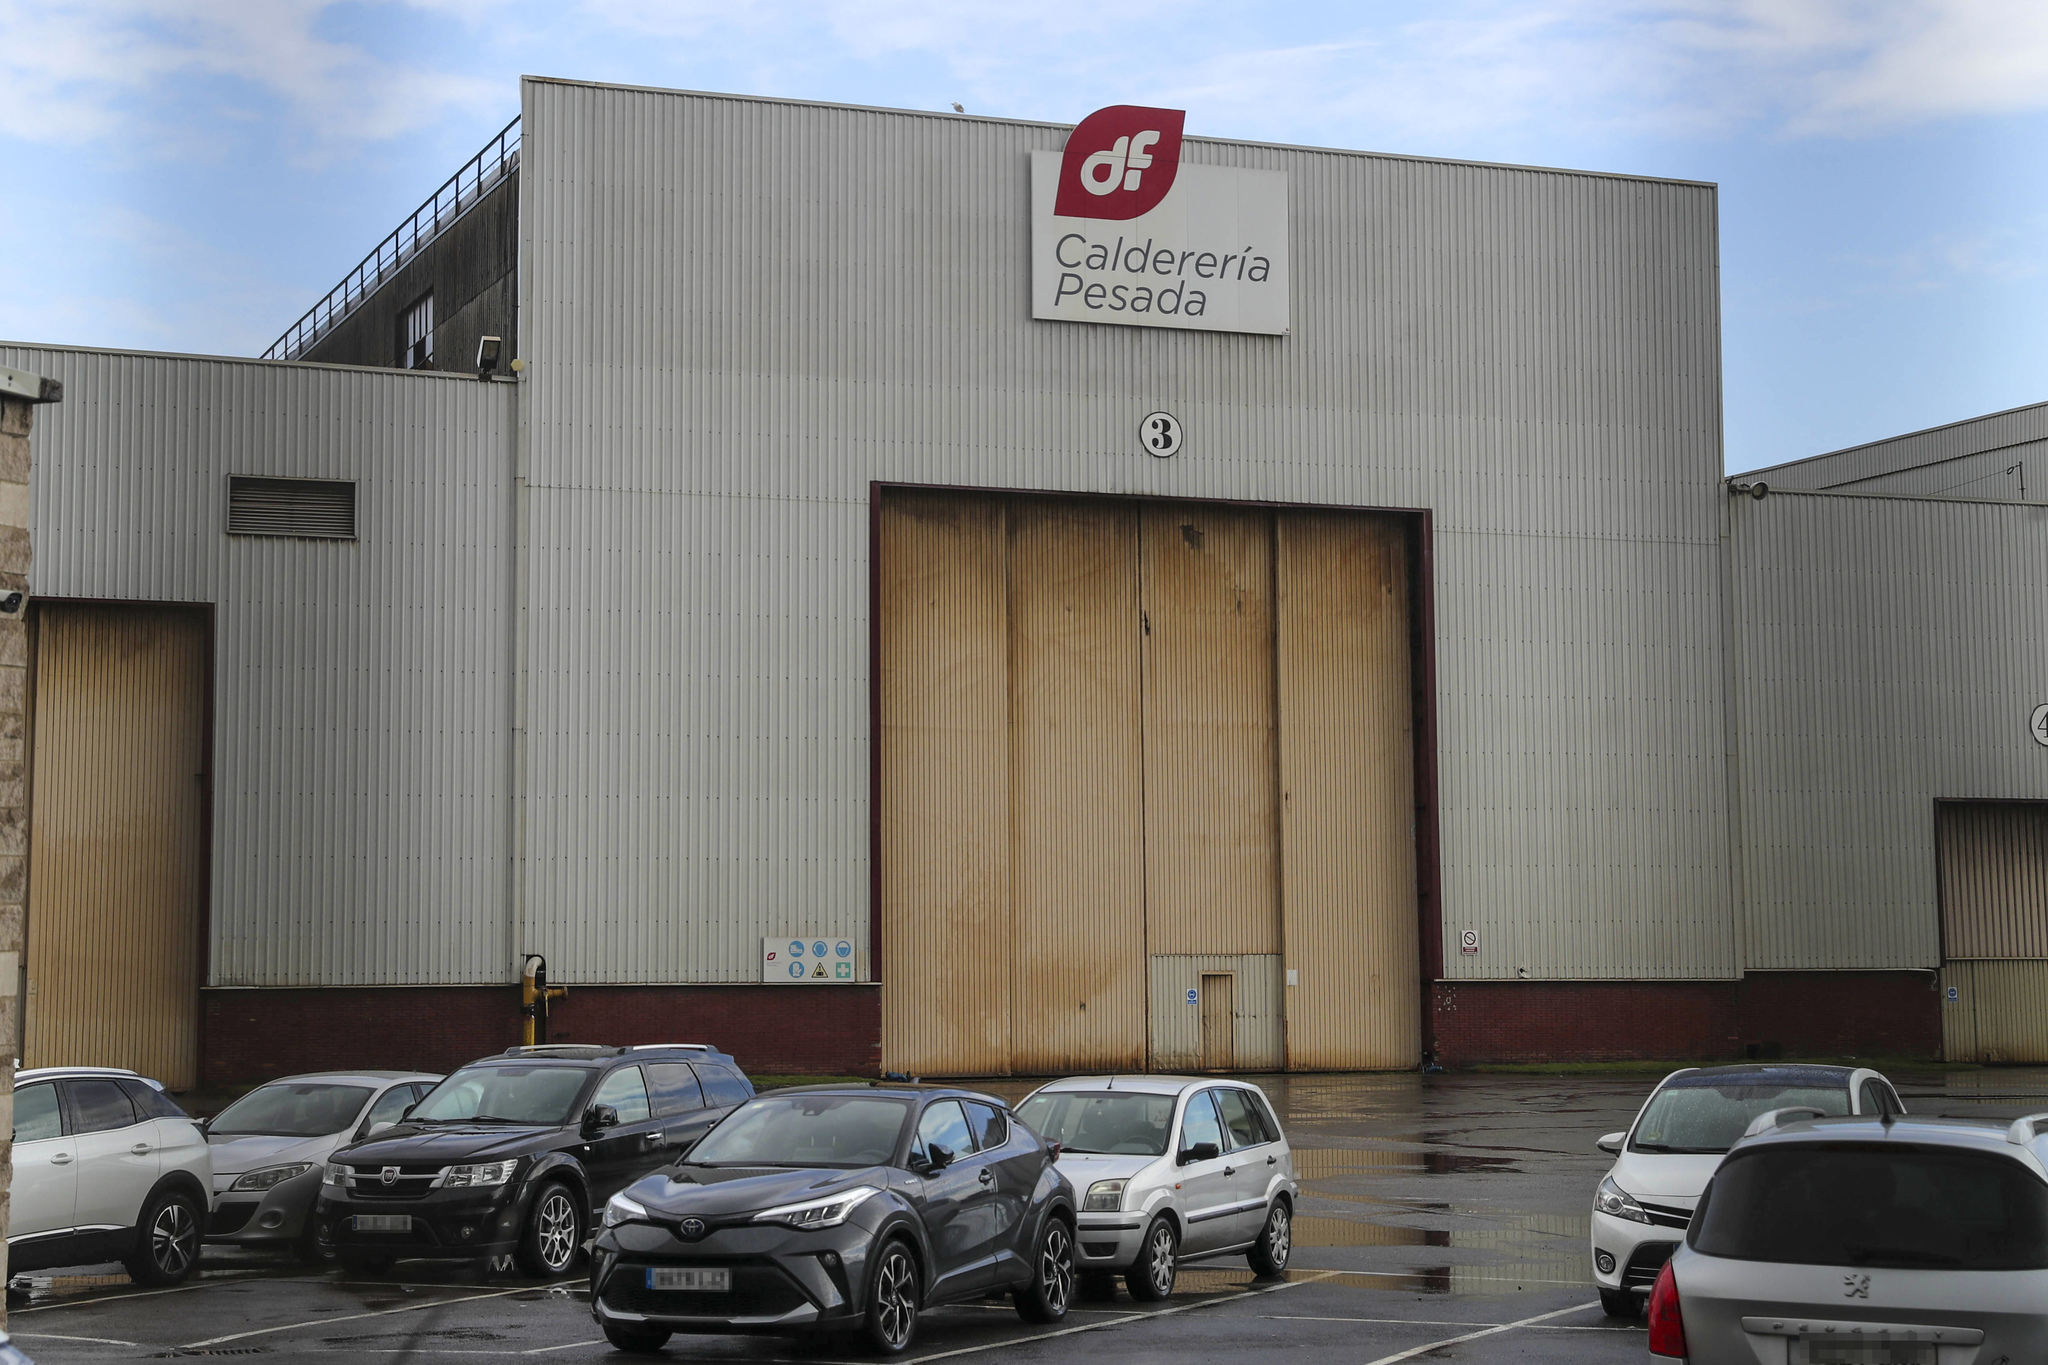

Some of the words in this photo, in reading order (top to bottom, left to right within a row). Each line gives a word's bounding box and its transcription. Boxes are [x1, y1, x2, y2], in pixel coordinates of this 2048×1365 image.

[1055, 233, 1271, 282] Calderería
[1054, 272, 1207, 316] Pesada
[1151, 418, 1173, 449] 3
